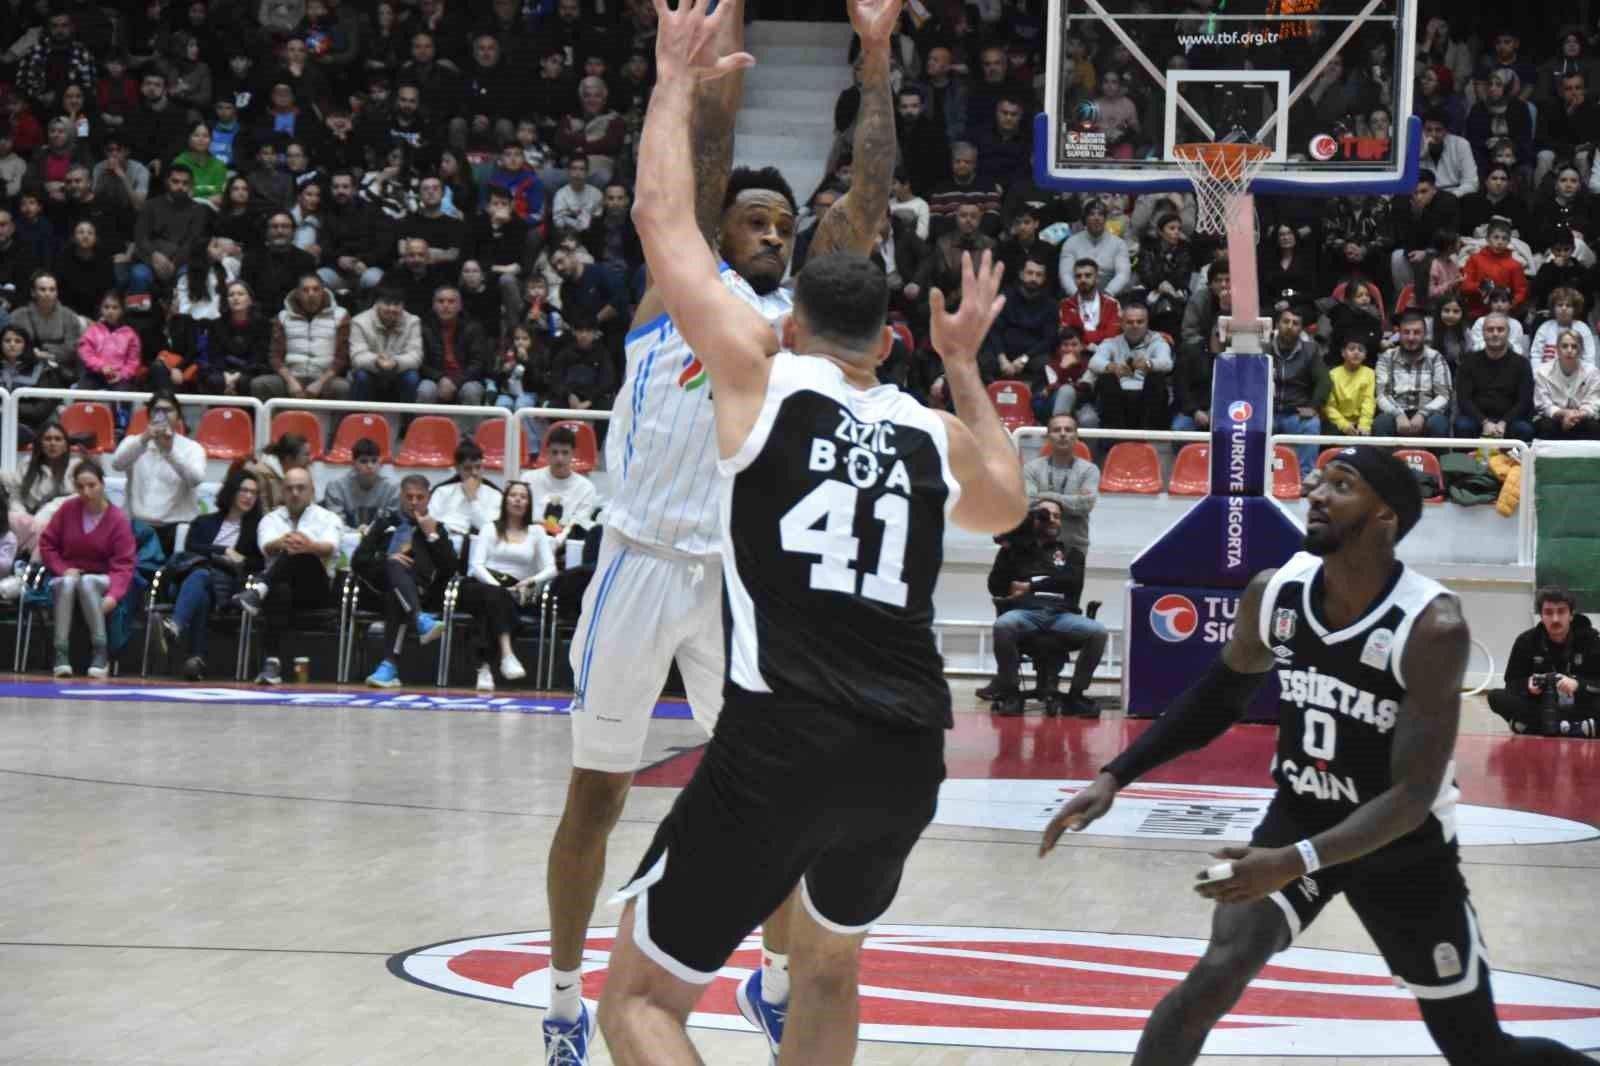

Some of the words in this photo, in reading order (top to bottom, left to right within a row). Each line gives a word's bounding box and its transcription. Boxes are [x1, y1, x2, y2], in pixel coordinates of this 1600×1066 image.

[1177, 31, 1279, 46] www.tbf.org.tr
[779, 479, 909, 608] 41
[1278, 666, 1399, 733] EŞİKTAŞ
[1302, 708, 1337, 761] 0
